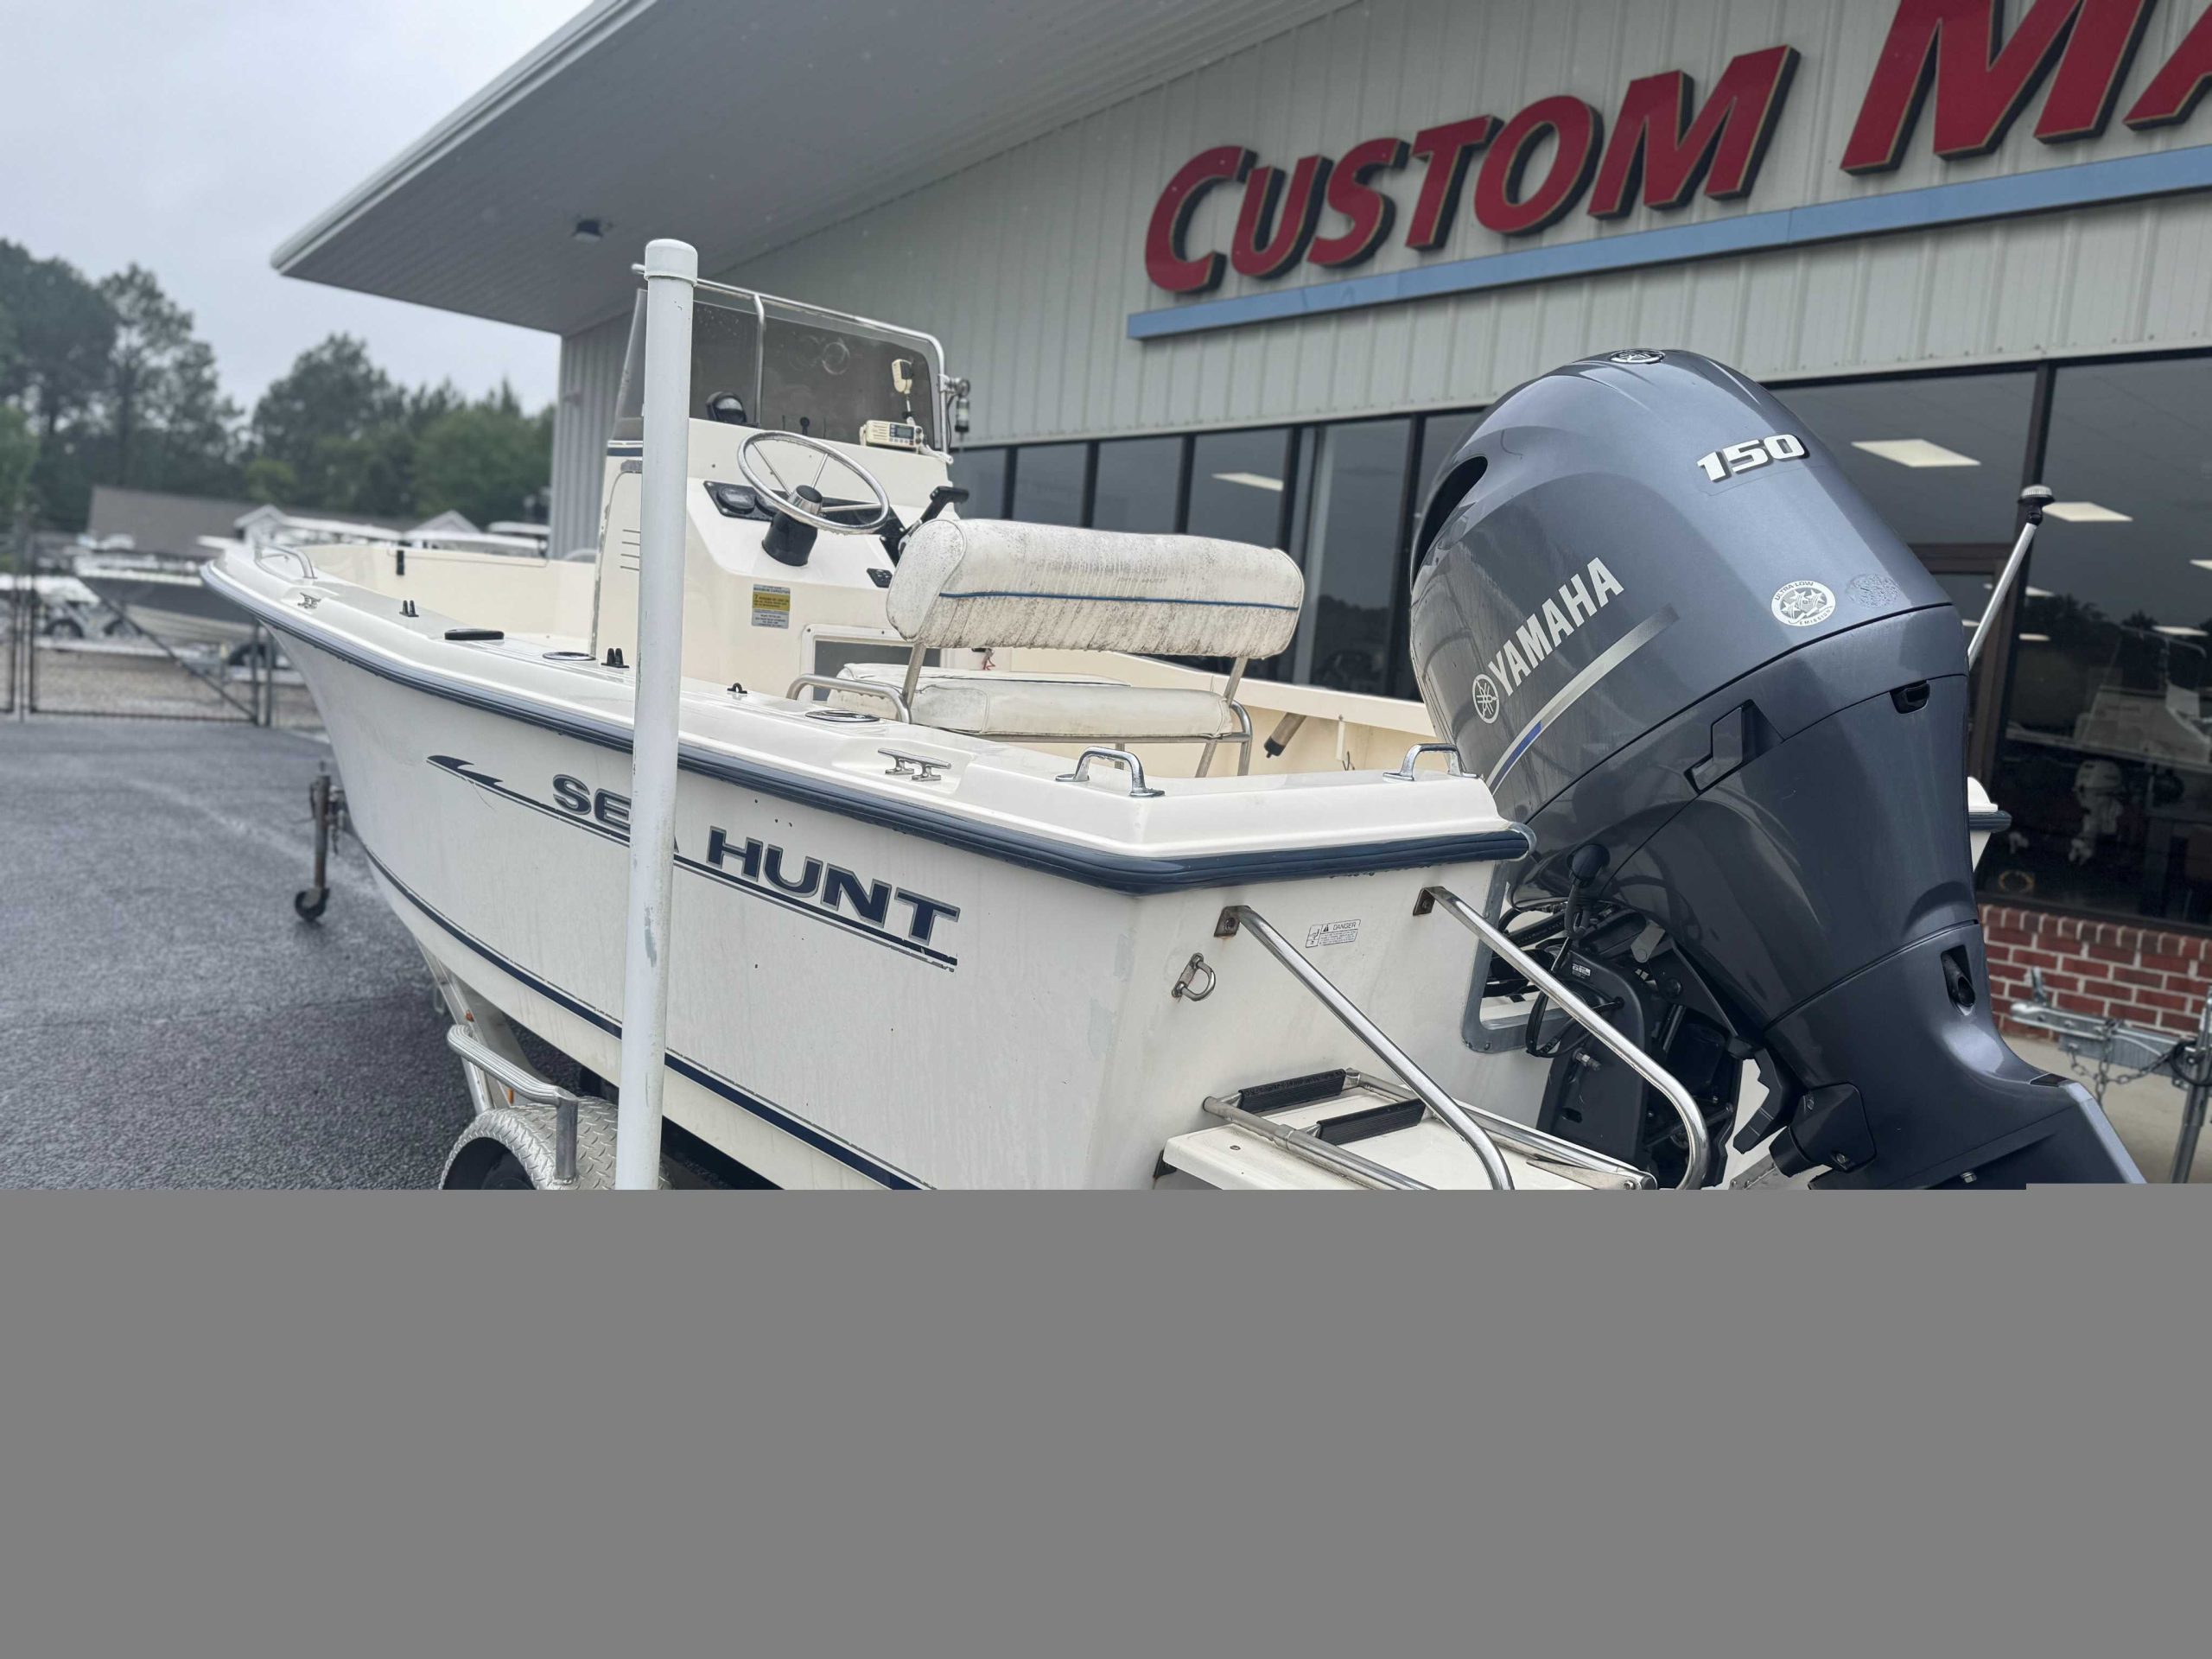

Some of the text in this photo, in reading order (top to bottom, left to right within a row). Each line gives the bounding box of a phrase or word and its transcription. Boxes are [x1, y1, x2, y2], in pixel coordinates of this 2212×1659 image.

[1144, 45, 1800, 293] CUSTOM
[1697, 434, 1809, 482] 150
[1488, 557, 1624, 696] YAMAHA
[553, 774, 961, 945] SE HUNT
[1332, 921, 1357, 931] DANGER
